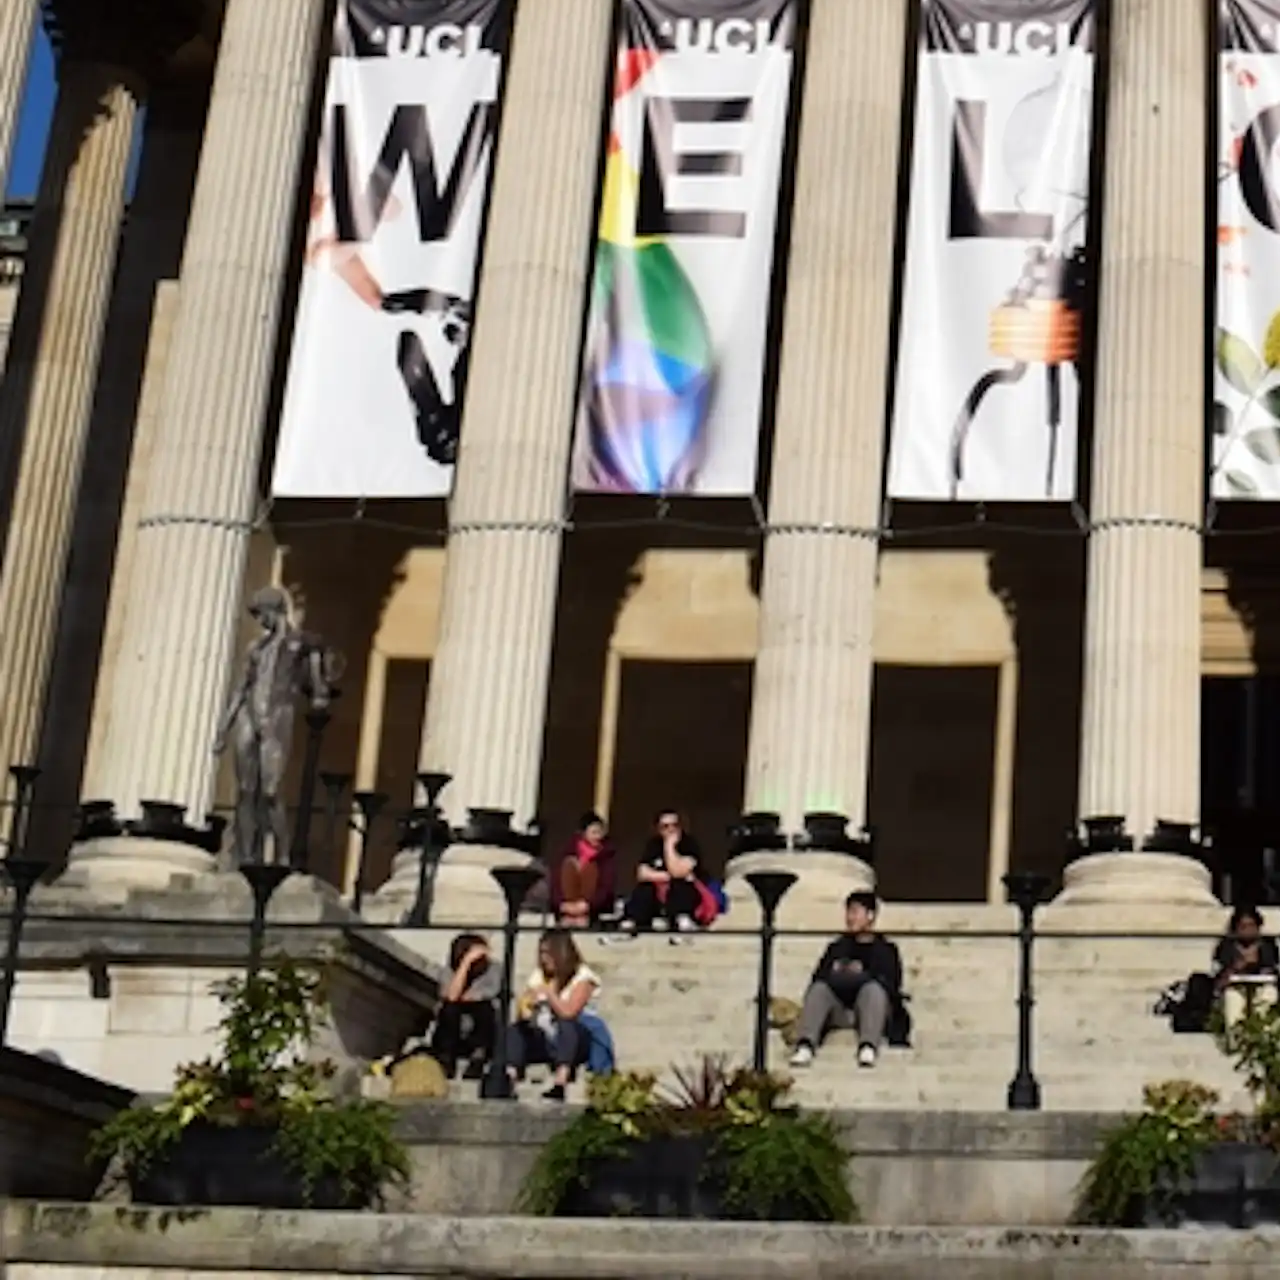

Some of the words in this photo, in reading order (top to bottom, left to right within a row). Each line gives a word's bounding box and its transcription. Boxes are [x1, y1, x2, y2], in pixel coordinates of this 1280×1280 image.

[387, 25, 494, 57] UCL
[675, 18, 782, 54] UCL
[975, 22, 1083, 56] UCL
[332, 102, 496, 242] W
[635, 97, 752, 237] E
[949, 100, 1054, 240] L
